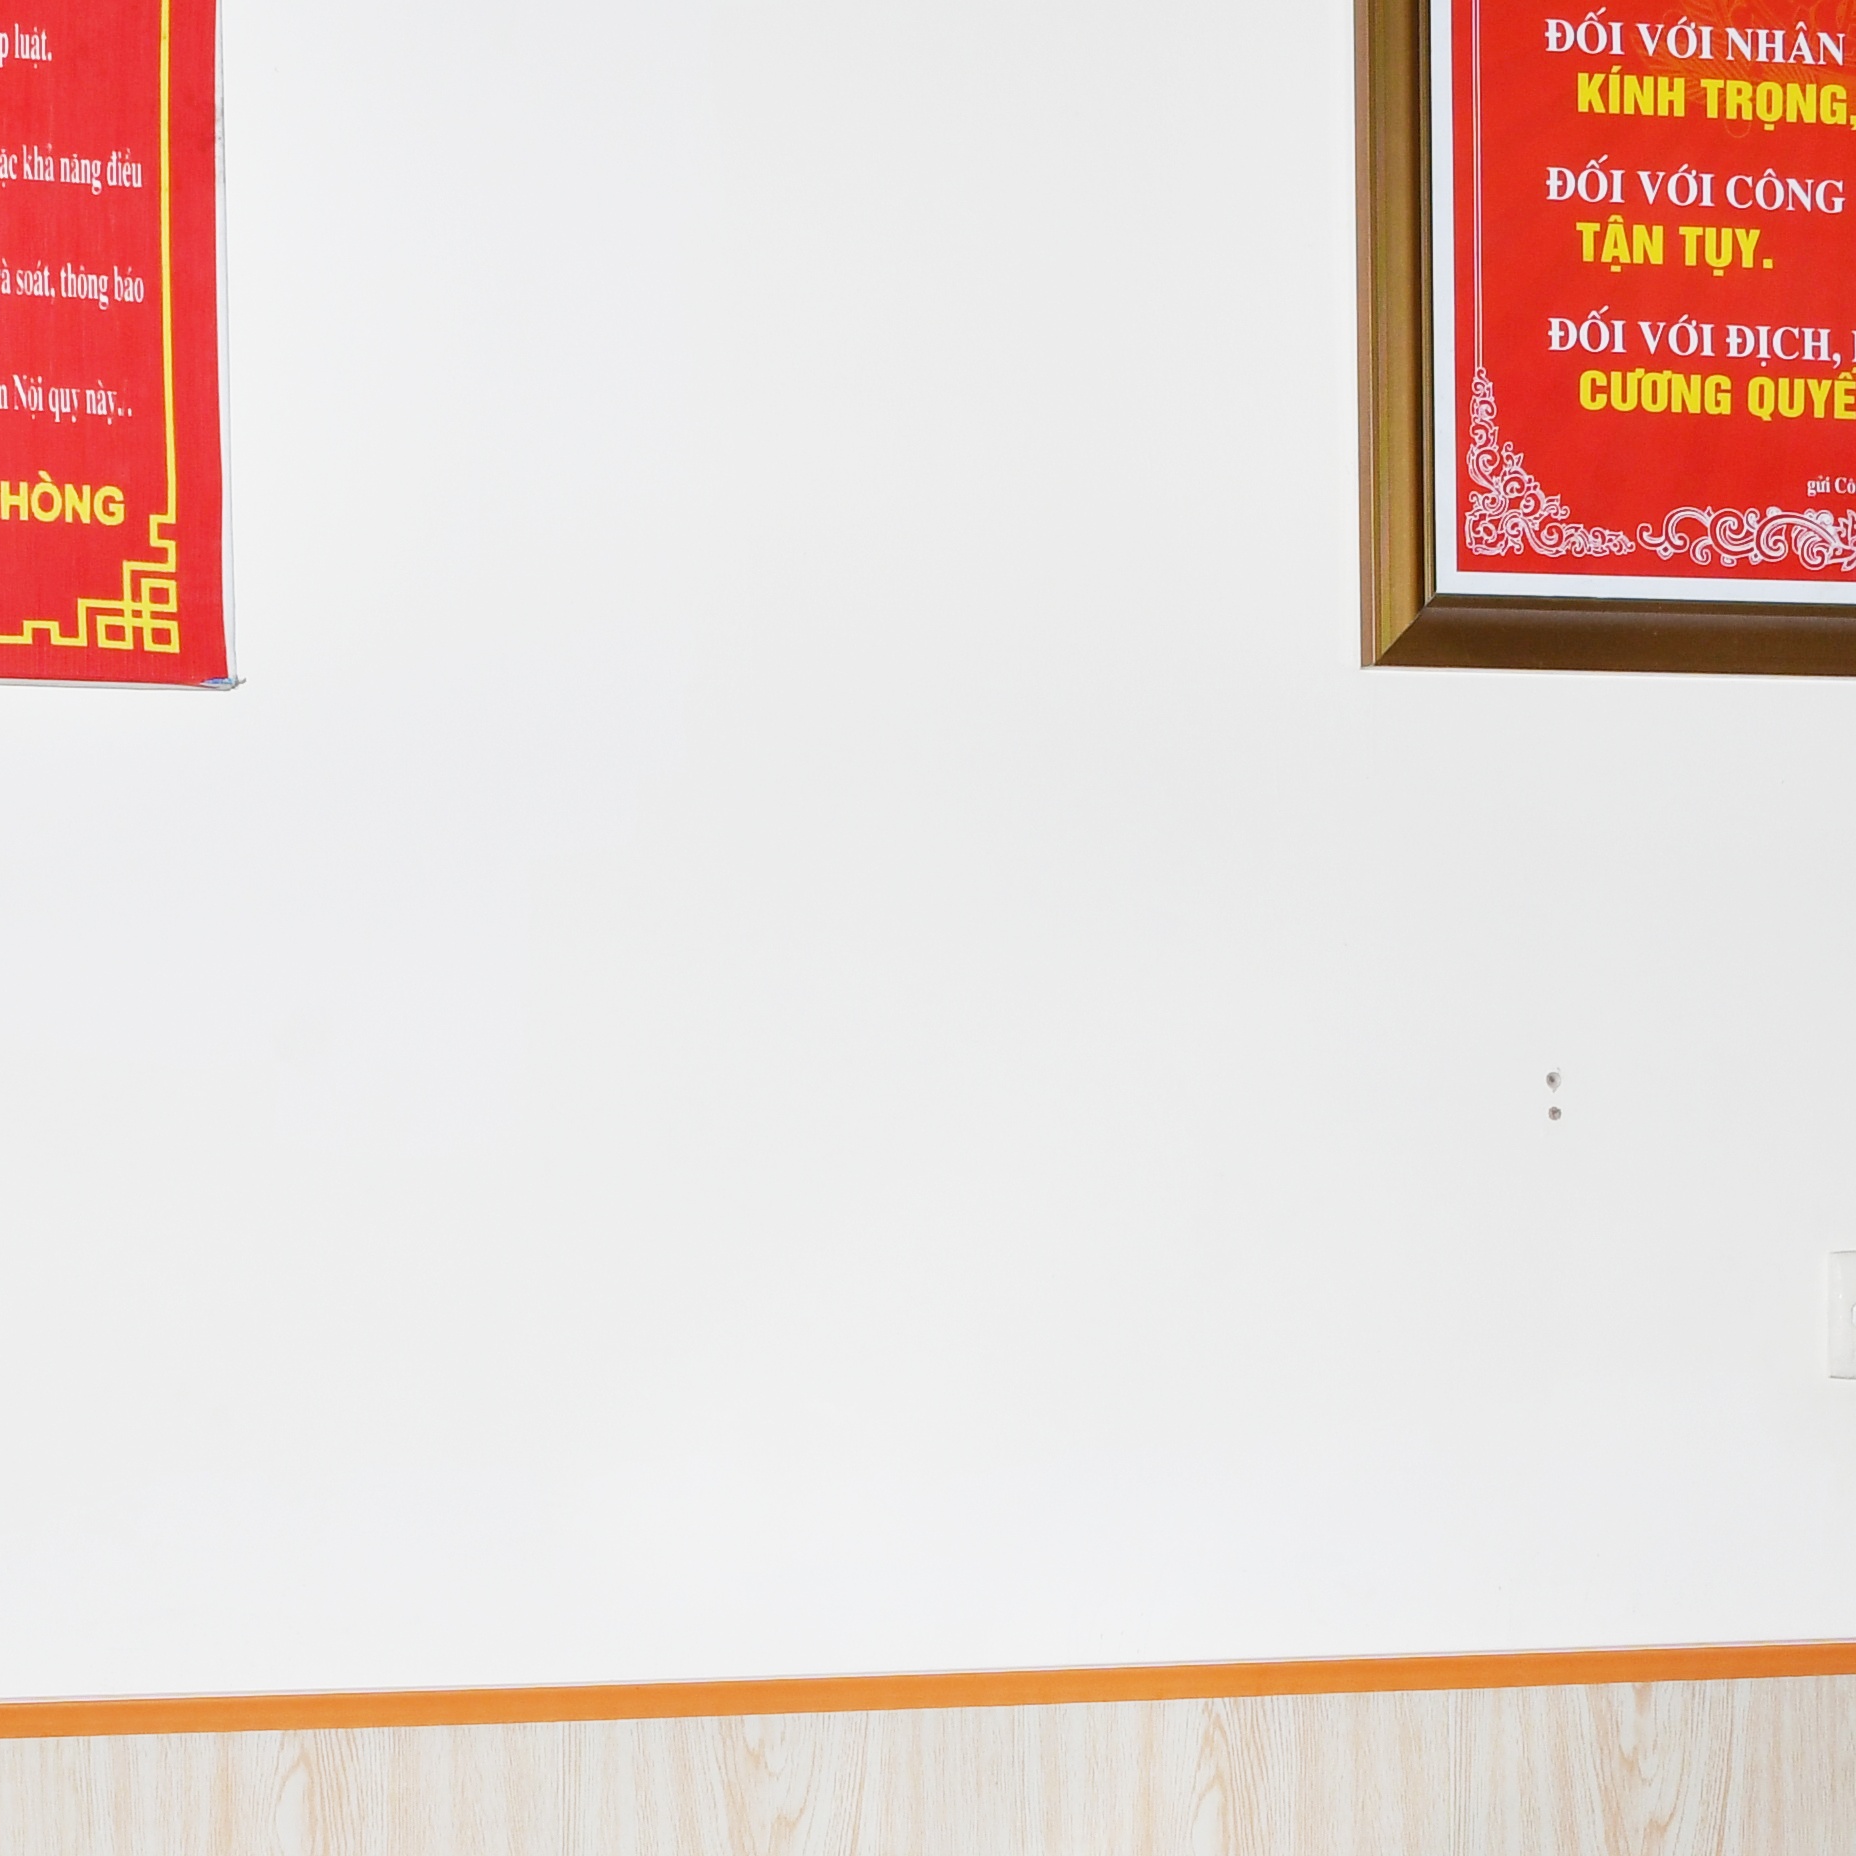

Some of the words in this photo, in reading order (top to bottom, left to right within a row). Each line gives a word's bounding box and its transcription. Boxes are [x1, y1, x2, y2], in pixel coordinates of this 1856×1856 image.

[1545, 7, 1623, 54] ĐỐI
[1637, 17, 1713, 58] VỚI
[1726, 21, 1844, 65] NHÂN
[1578, 66, 1684, 116] KÍNH
[1546, 155, 1624, 202] ĐỐI
[1638, 164, 1714, 206] VỚI
[1727, 169, 1844, 213] CÔNG
[1577, 215, 1663, 272] TẬN
[1679, 227, 1772, 276] TỤY.
[1548, 306, 1626, 352] ĐỐI
[1639, 315, 1714, 356] VỚI
[1726, 325, 1840, 368] ĐỊCH,
[1580, 369, 1731, 414] CƯƠNG
[1808, 477, 1830, 496] gửi
